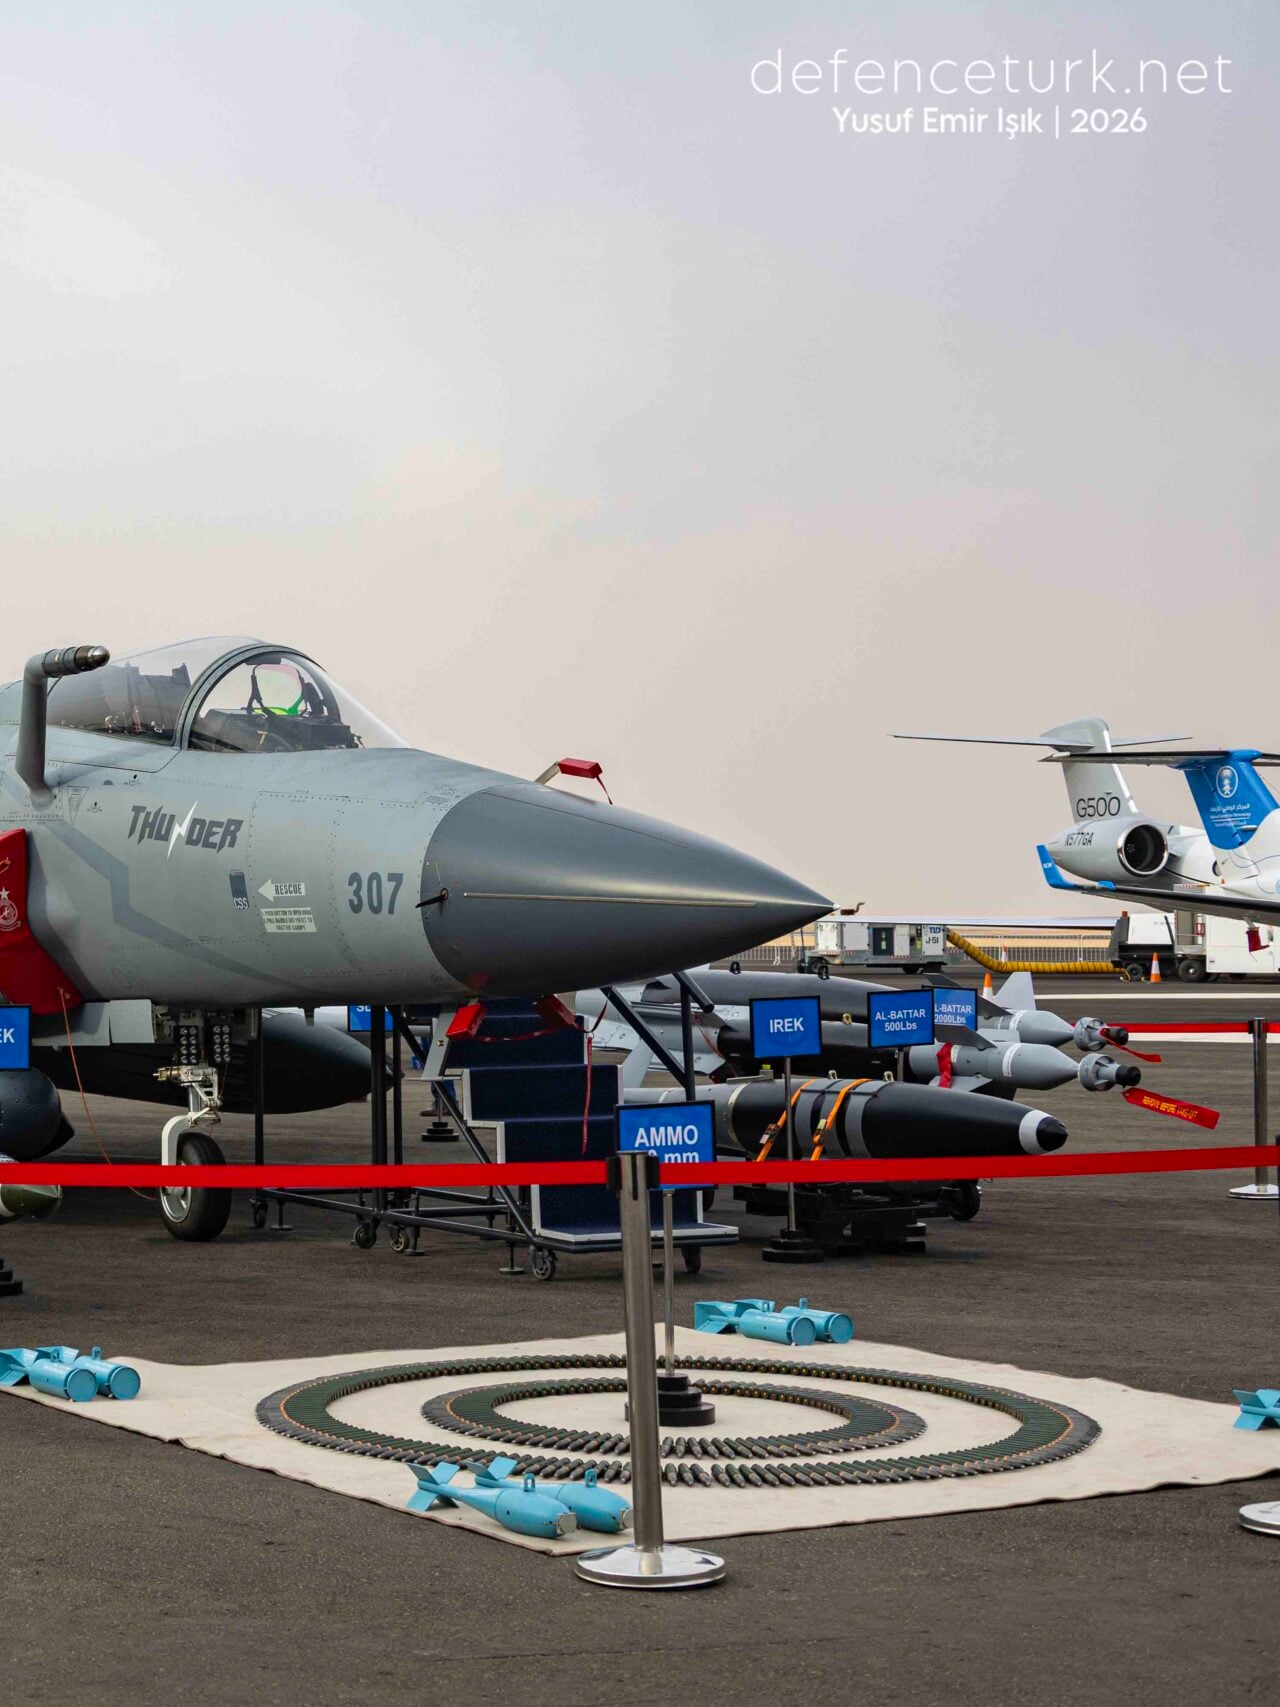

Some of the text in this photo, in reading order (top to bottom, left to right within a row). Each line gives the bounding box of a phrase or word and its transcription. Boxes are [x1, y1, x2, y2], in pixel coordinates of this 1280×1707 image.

[1076, 796, 1121, 818] G500
[128, 800, 244, 859] THUNDER
[275, 883, 303, 895] RESCUE
[347, 871, 404, 915] 307
[233, 897, 249, 909] CSS
[875, 1009, 926, 1021] AL-BATTAR
[935, 1004, 972, 1014] L-BATTAR
[770, 1017, 805, 1033] IREK
[934, 1014, 966, 1024] 2000Lbs
[884, 1021, 917, 1032] 500Lbs
[634, 1125, 699, 1148] AMMO
[664, 1151, 699, 1163] mm
